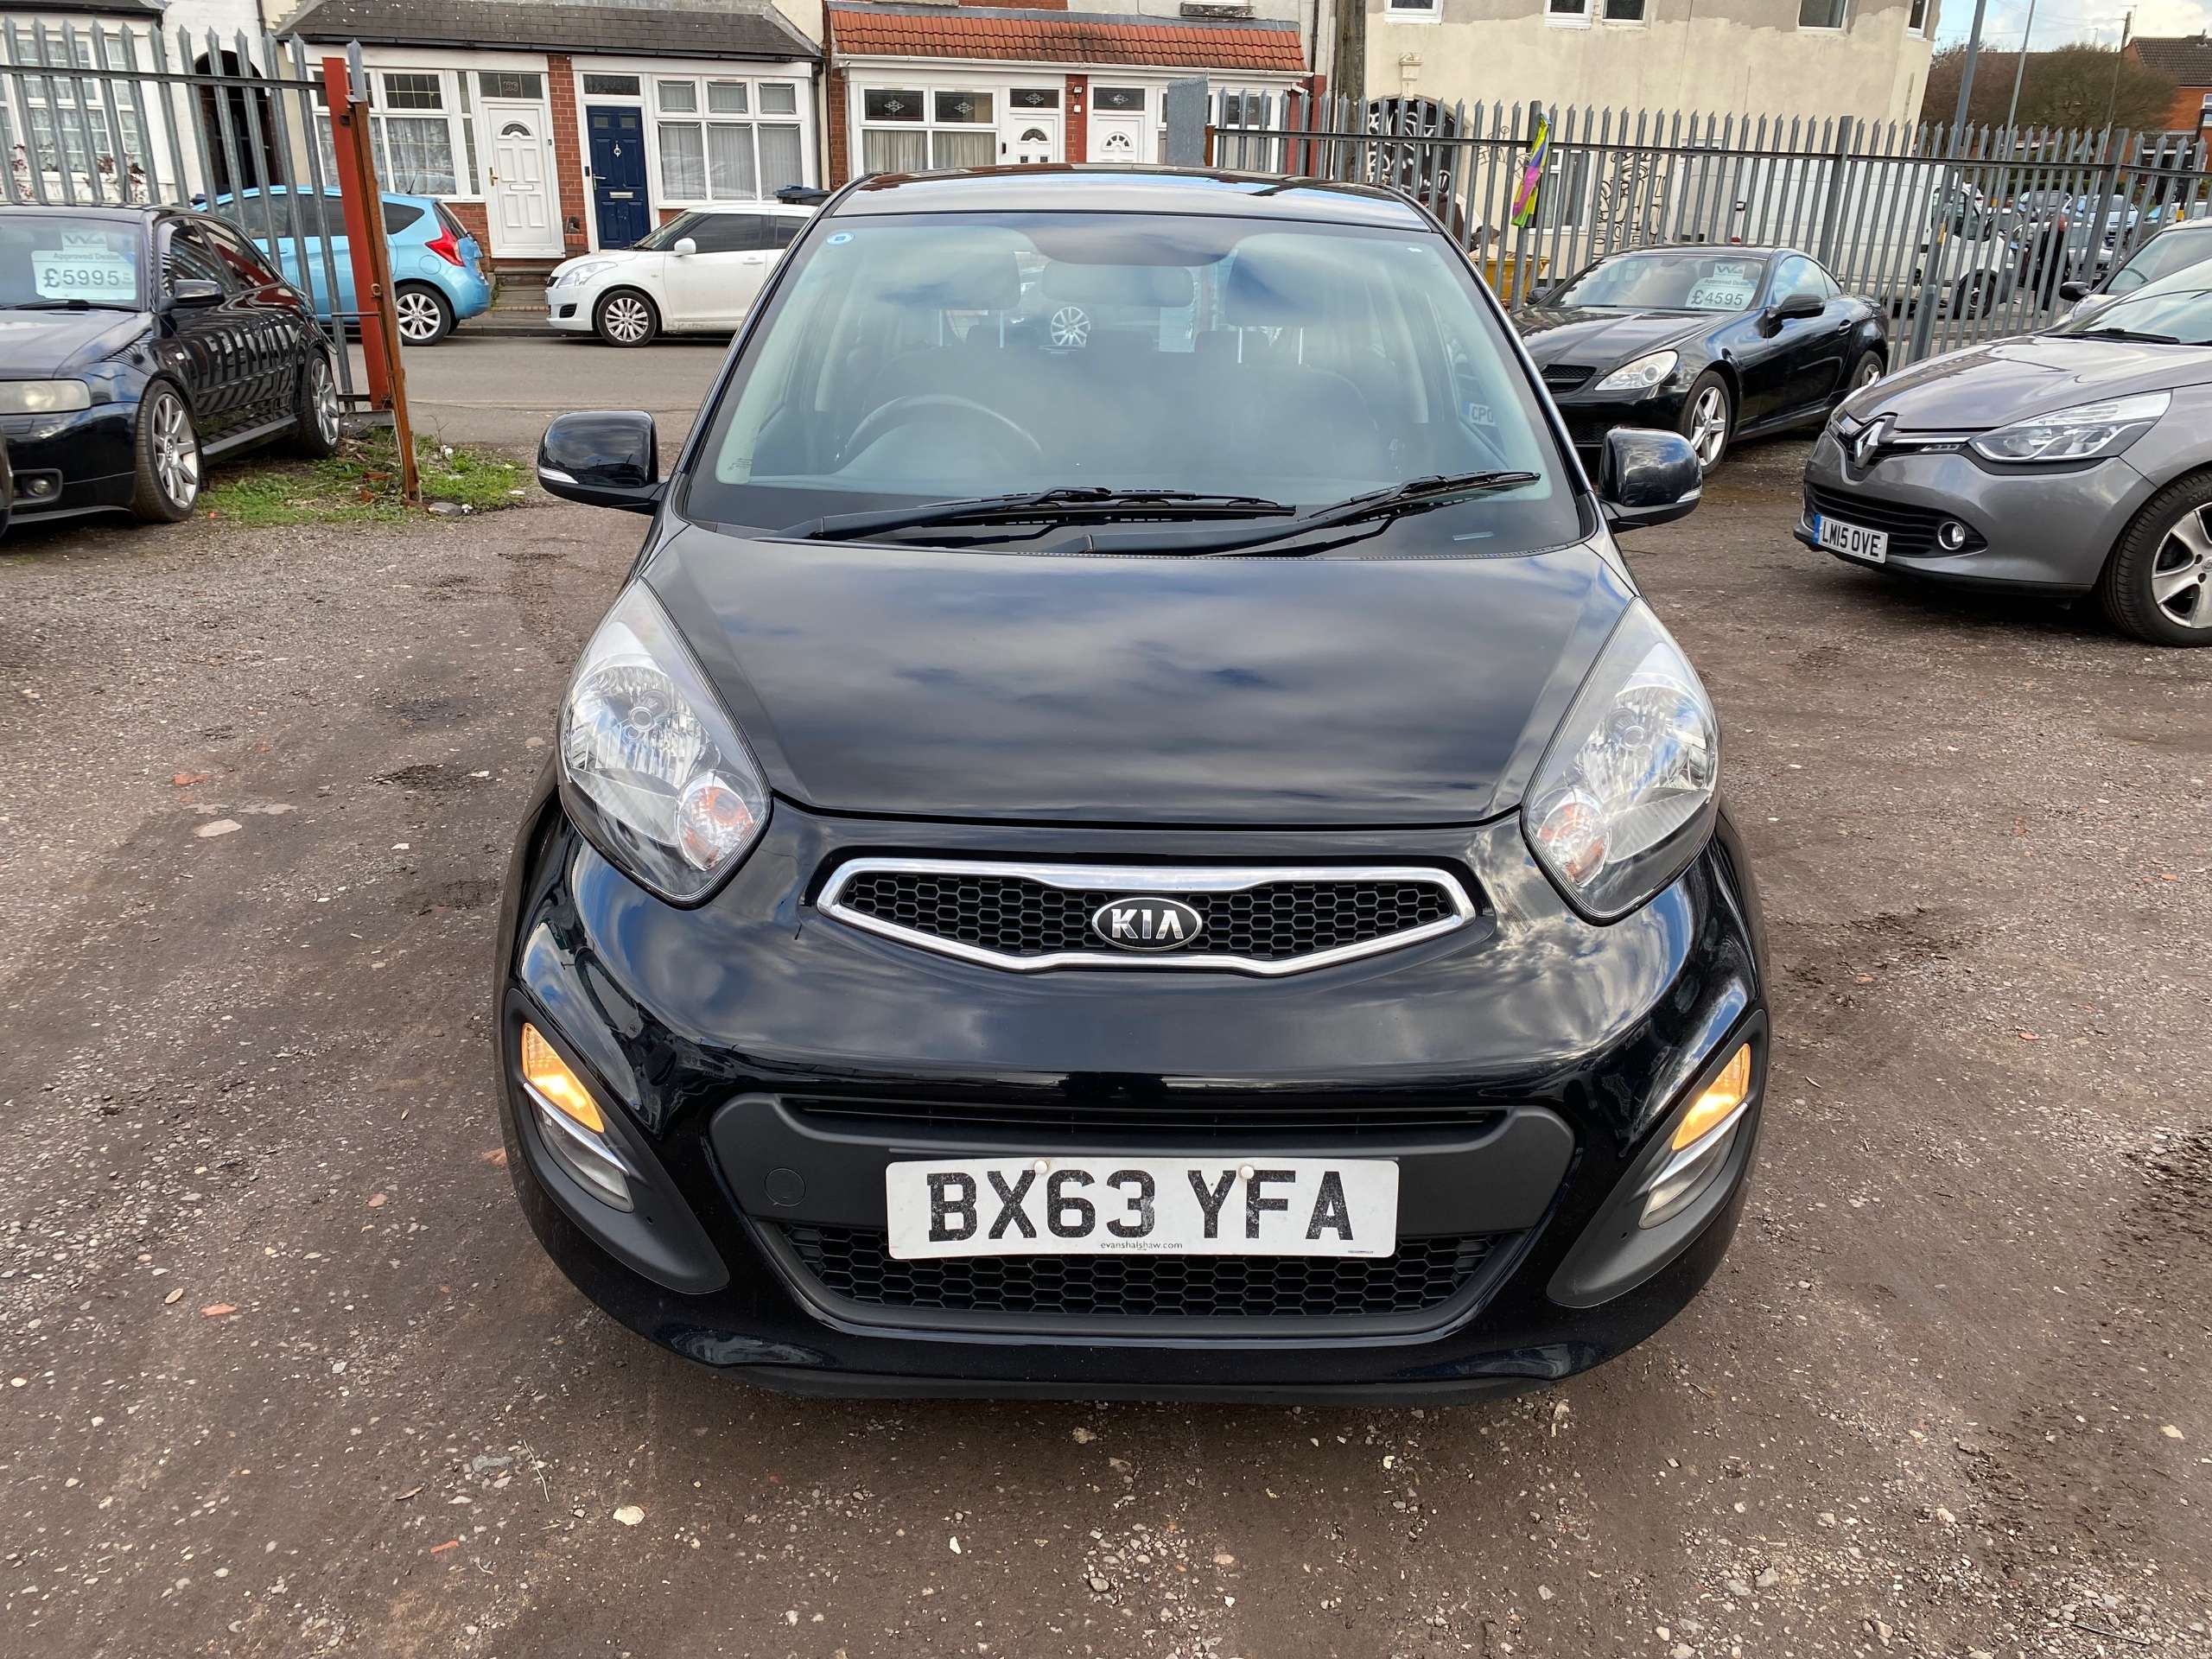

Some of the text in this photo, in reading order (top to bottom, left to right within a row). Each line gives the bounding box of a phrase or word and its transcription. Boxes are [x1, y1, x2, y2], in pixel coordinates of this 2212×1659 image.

[43, 268, 119, 288] £5995
[1691, 289, 1744, 305] £4595
[1822, 521, 1881, 557] LM15 OVE
[1111, 908, 1184, 939] KIA
[927, 1169, 1354, 1242] BX63 YFA
[1100, 1241, 1183, 1249] evanshalshaw.com
